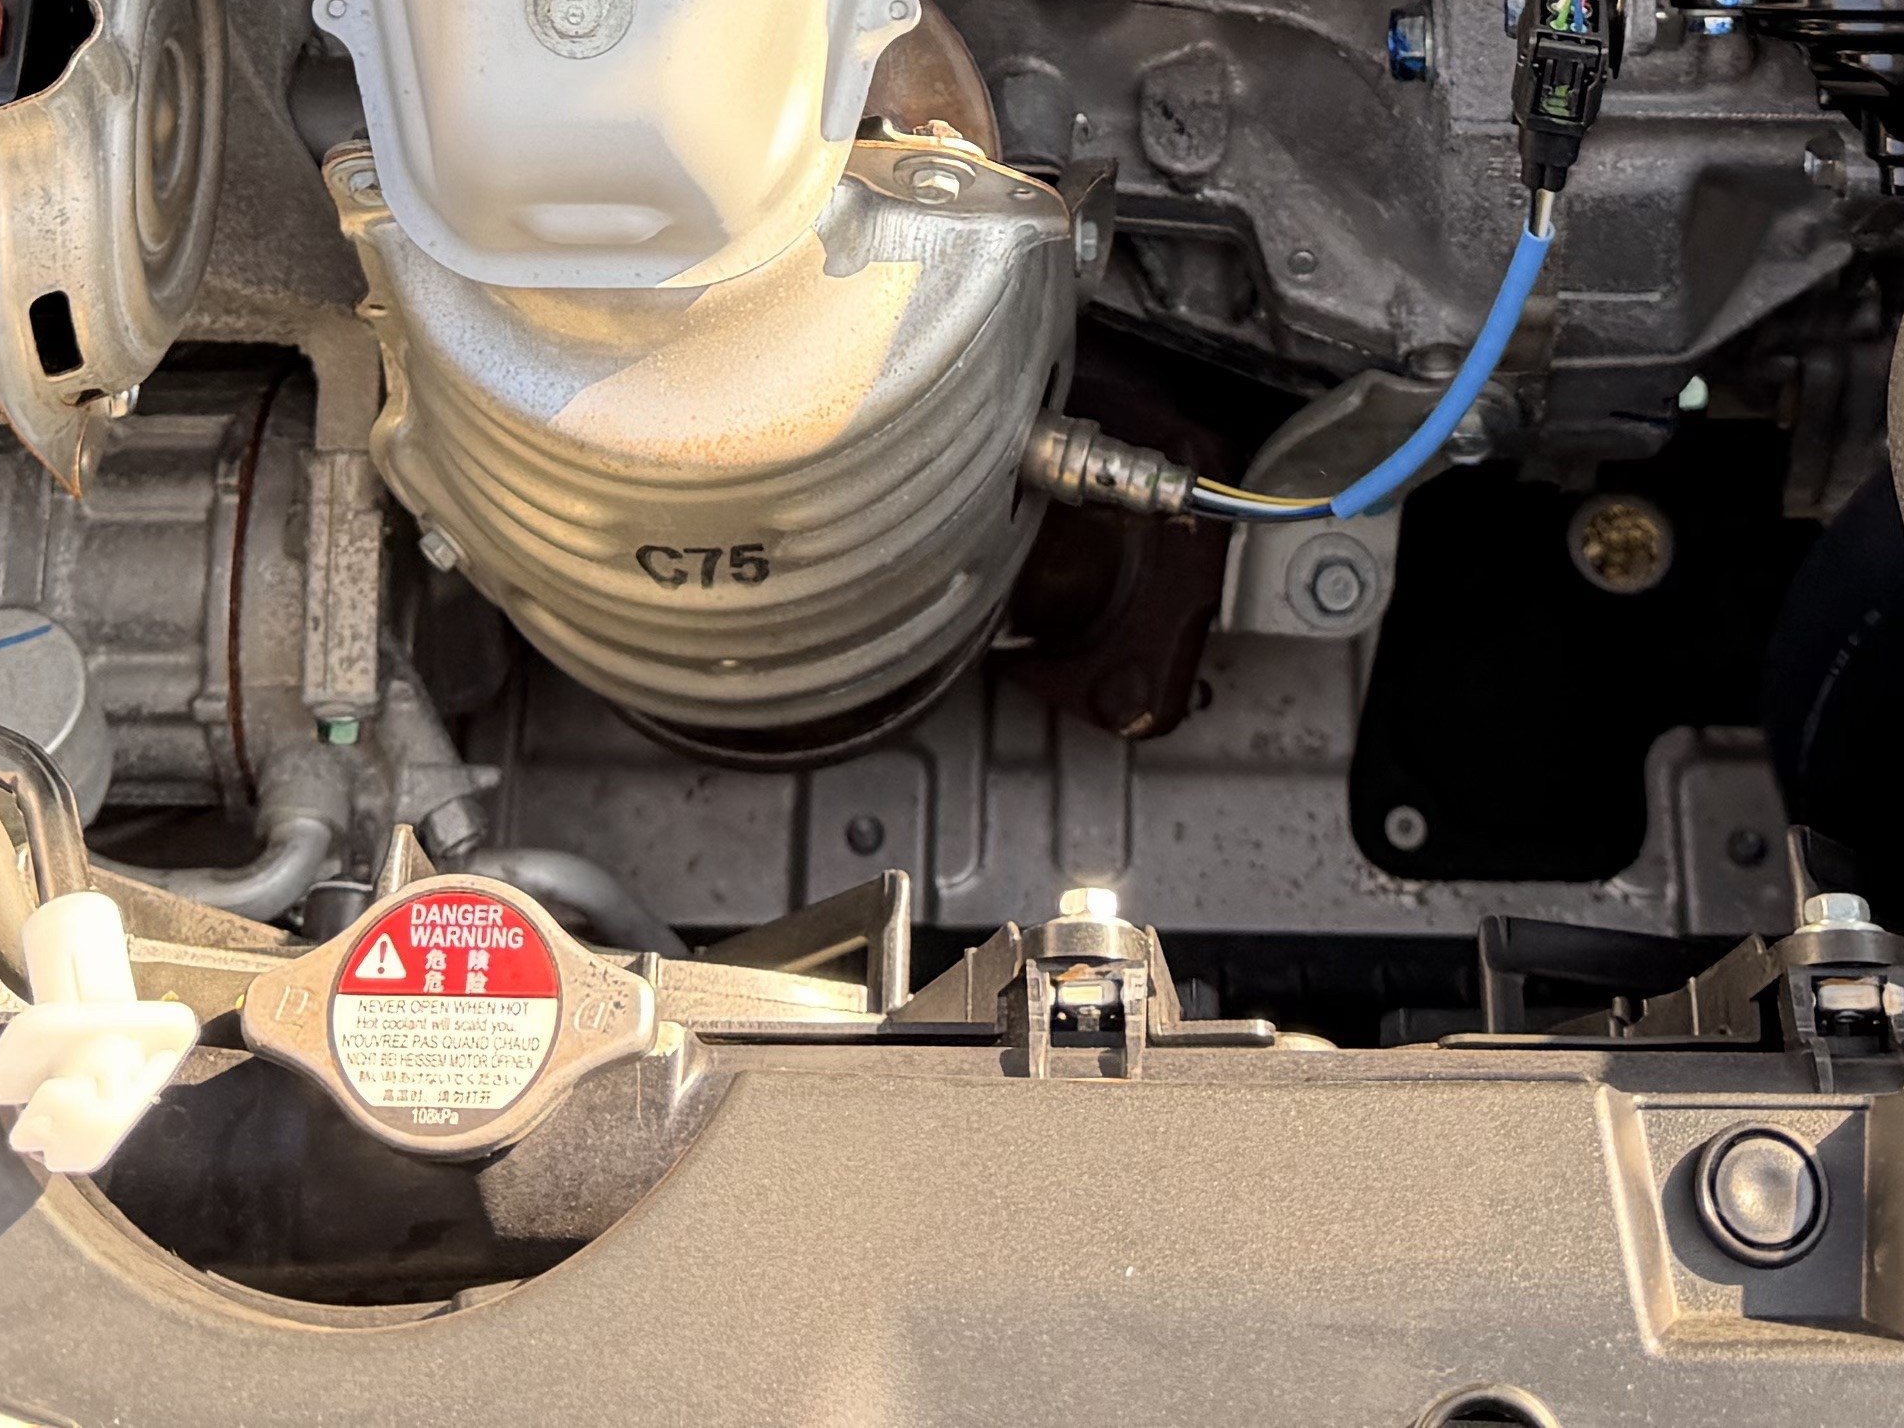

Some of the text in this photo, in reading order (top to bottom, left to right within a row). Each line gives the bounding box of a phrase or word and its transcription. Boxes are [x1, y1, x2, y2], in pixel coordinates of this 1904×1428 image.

[635, 542, 771, 590] C75
[411, 904, 504, 926] DANGER
[410, 926, 524, 949] WARNUNG
[357, 999, 529, 1015] NEVER OPEN WHEN HOT
[356, 1016, 378, 1029] Hot
[342, 1034, 540, 1052] N'OUVREZ PAS QUAND CHAUD
[451, 1054, 488, 1068] MOTOR
